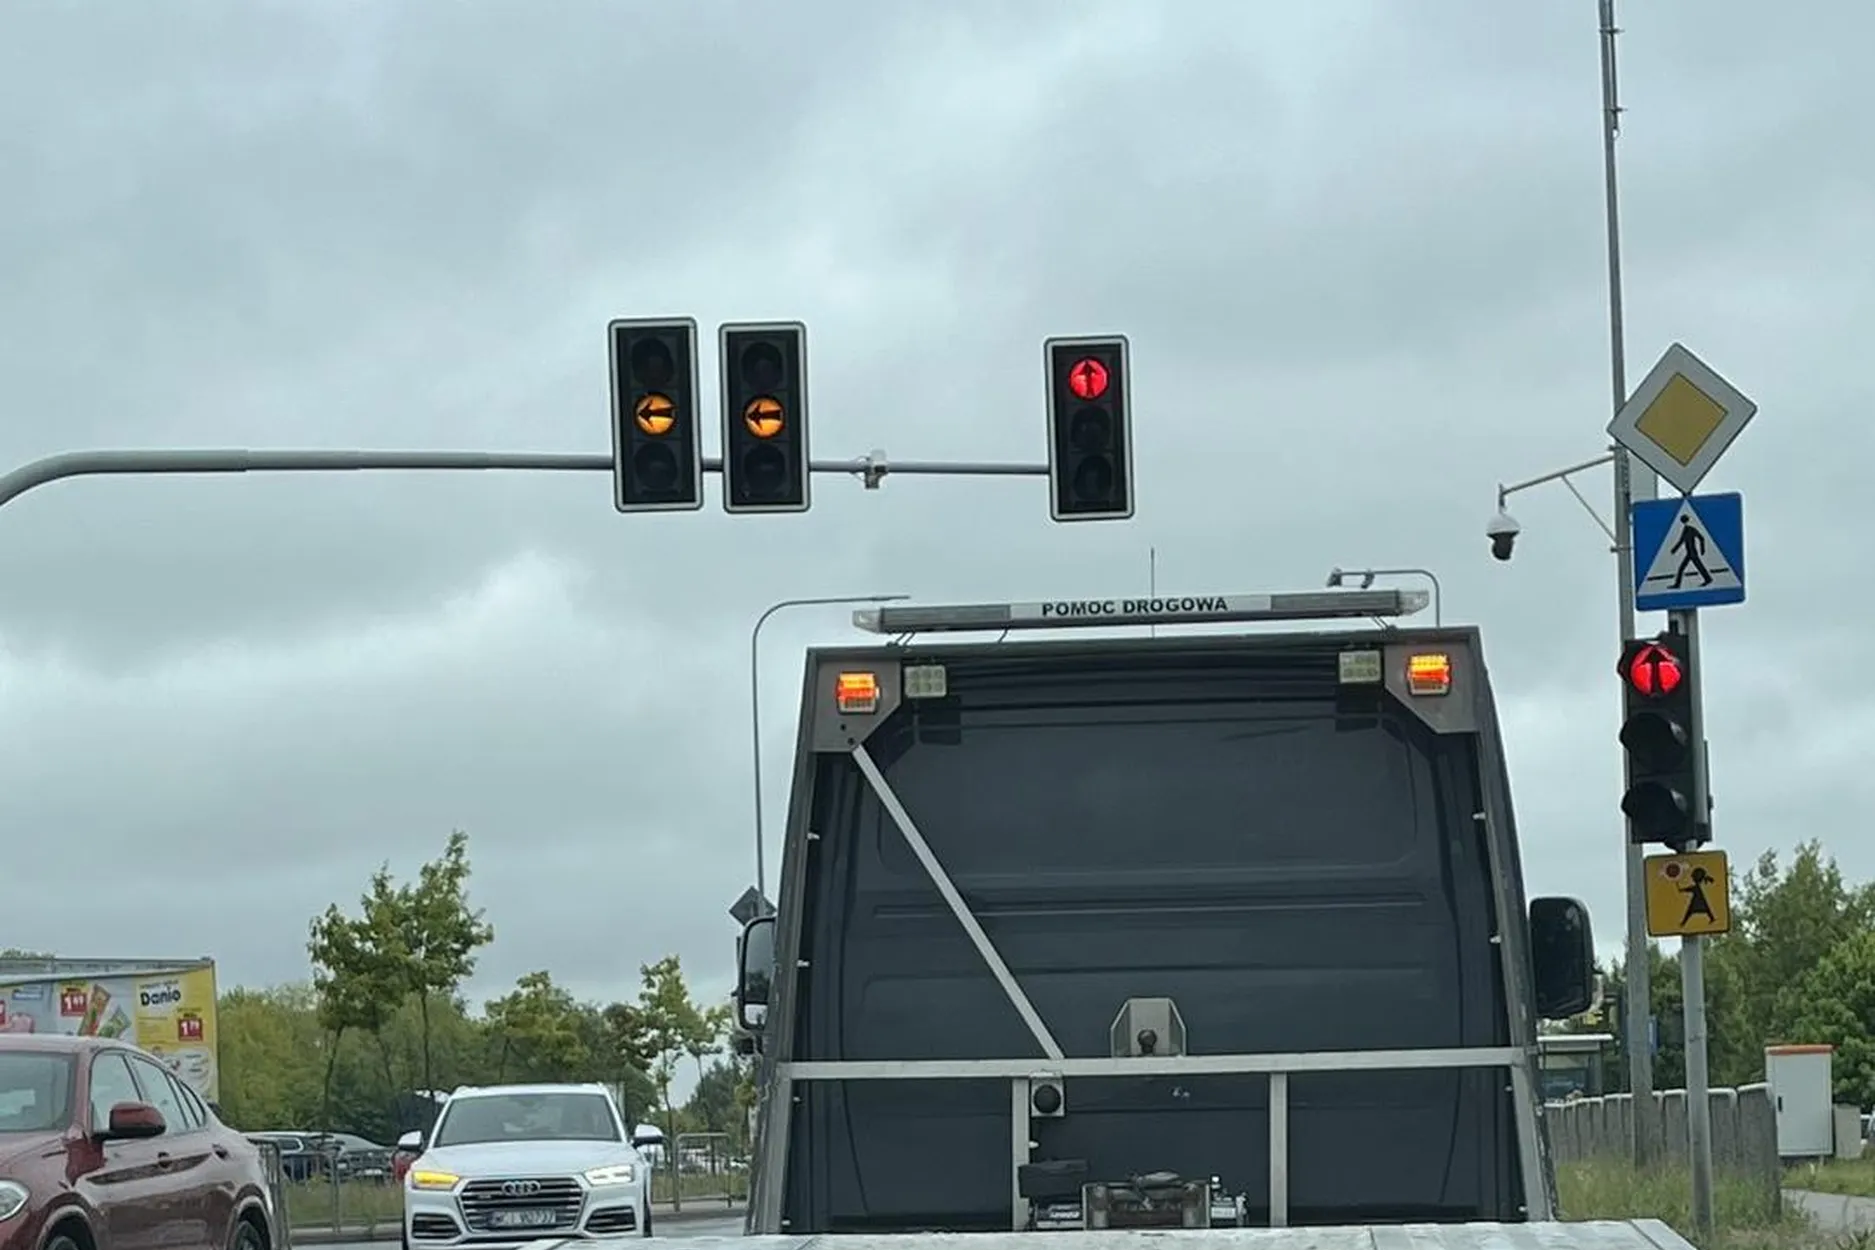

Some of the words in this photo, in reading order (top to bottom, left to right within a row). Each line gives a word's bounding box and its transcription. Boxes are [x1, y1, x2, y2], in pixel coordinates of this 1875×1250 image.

[1042, 601, 1116, 616] POMOC
[1123, 597, 1229, 614] DROGOWA
[140, 985, 181, 1006] Danio
